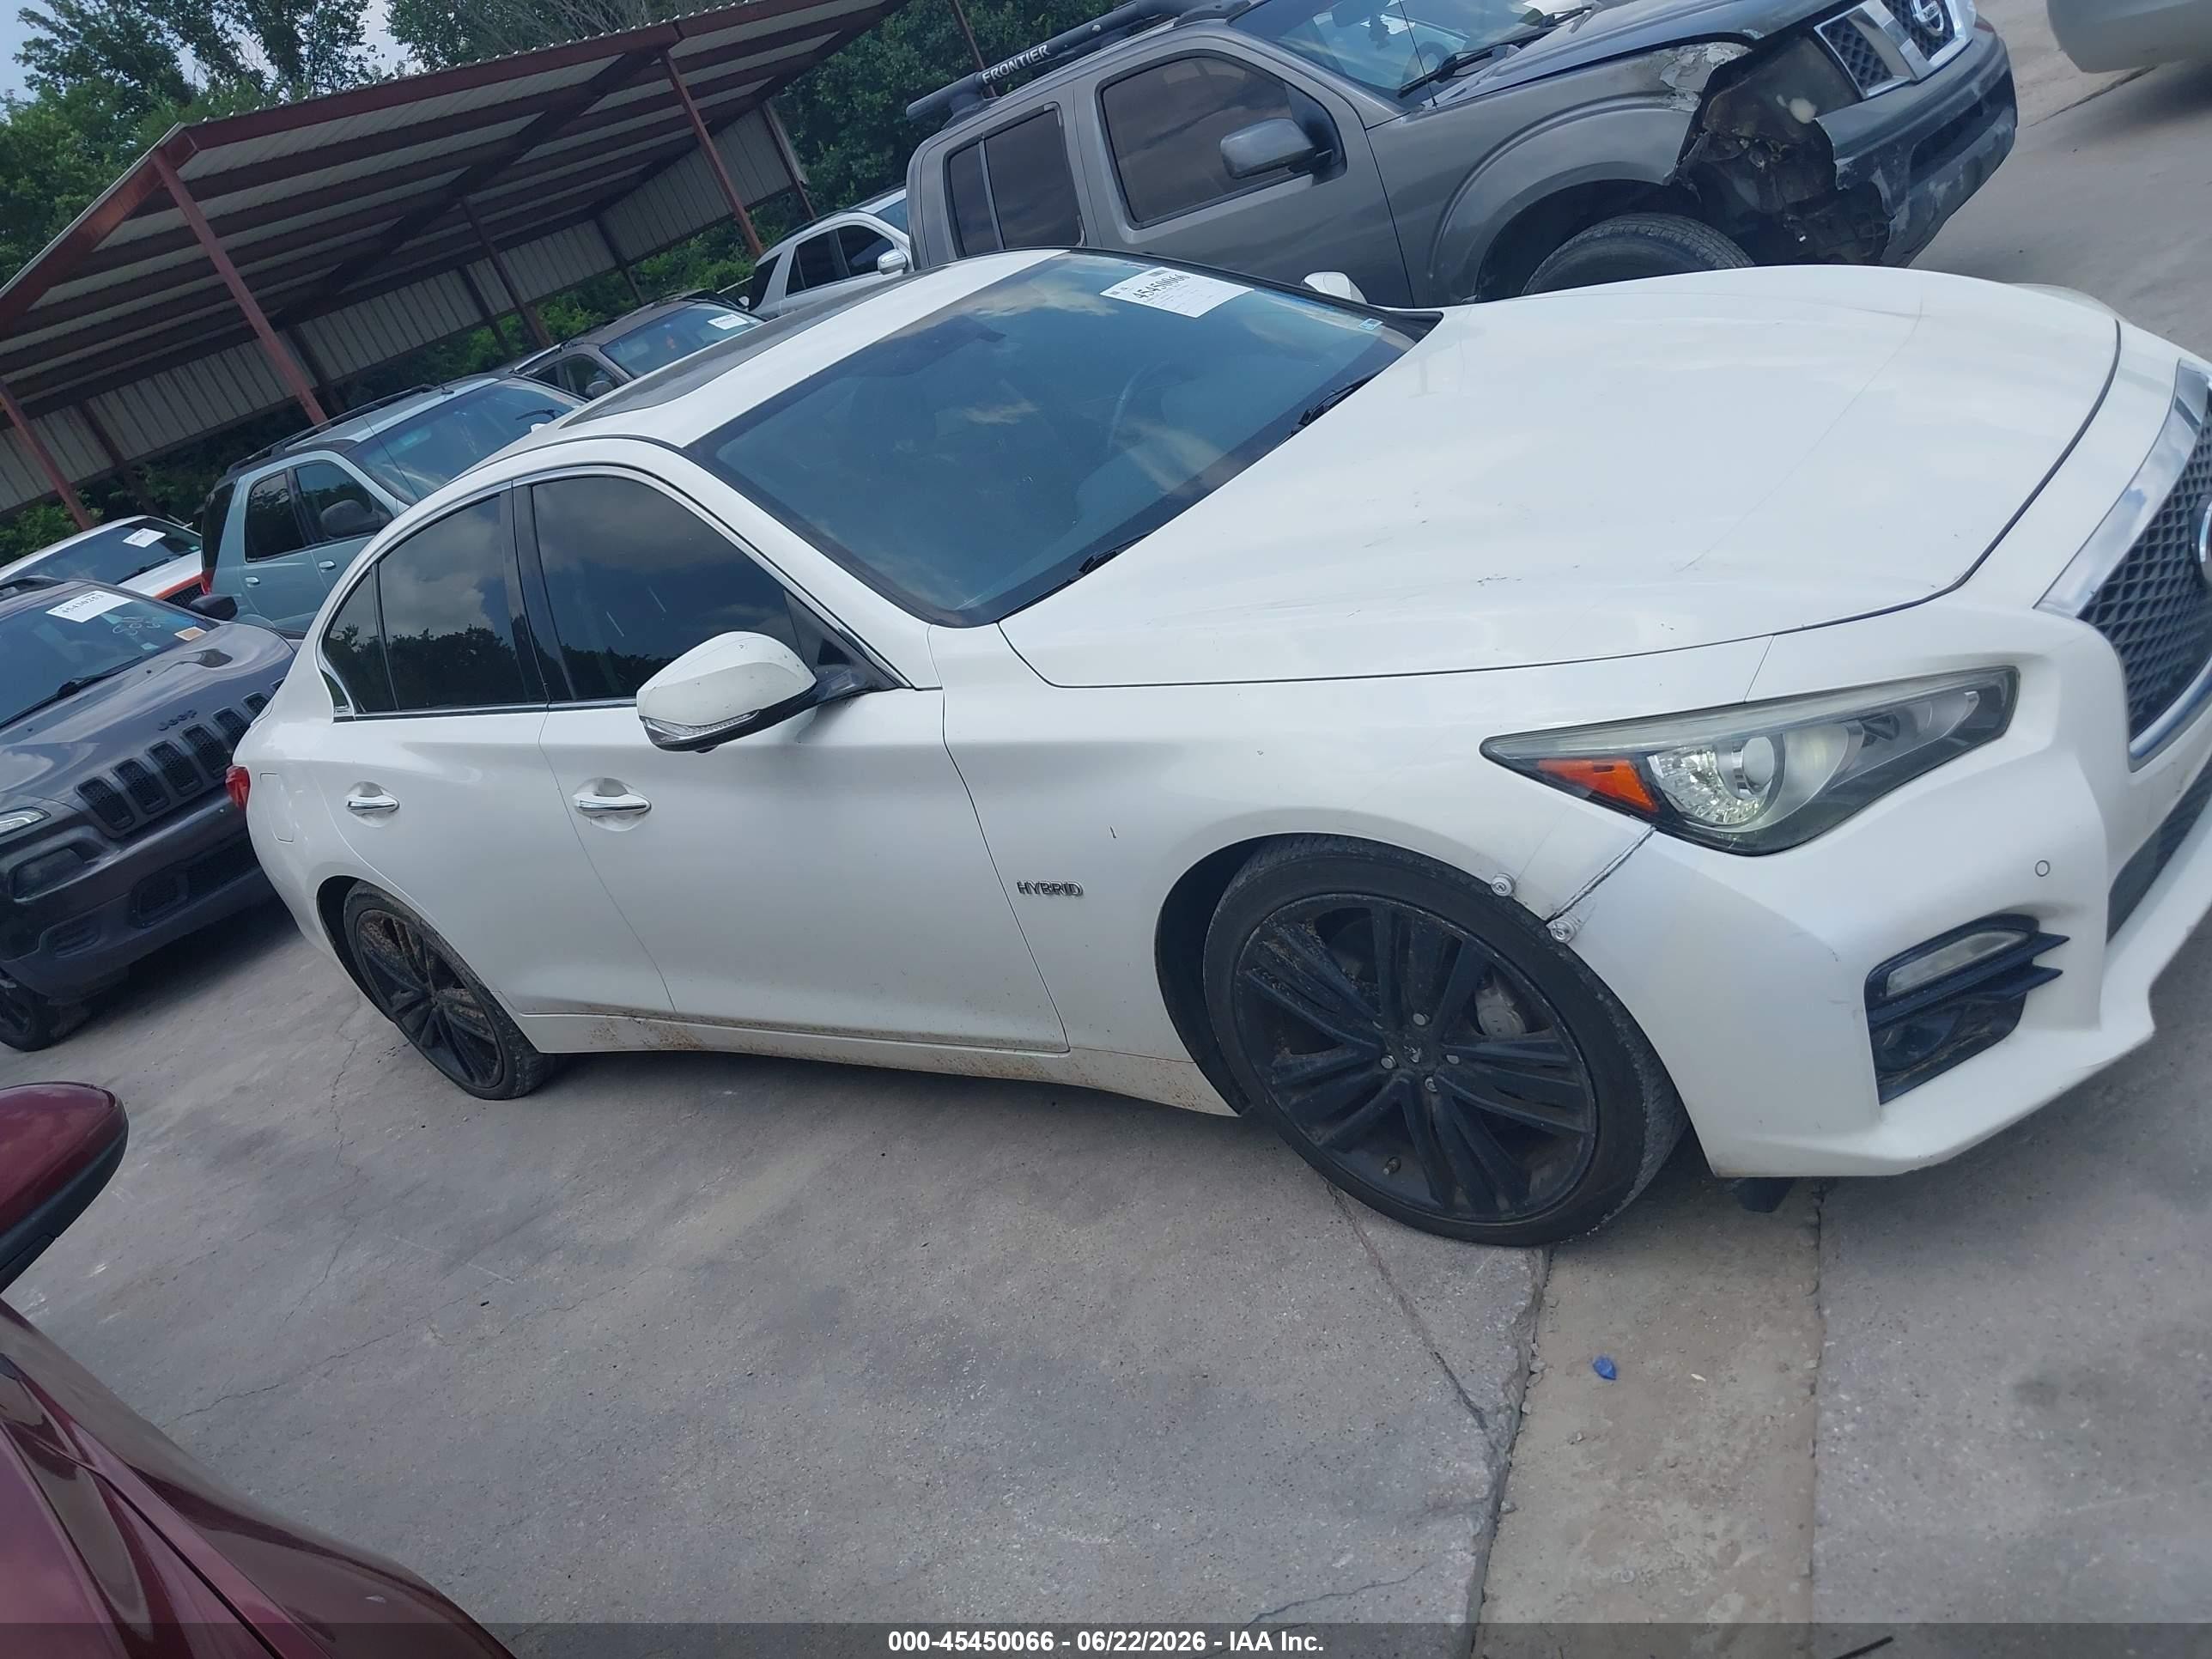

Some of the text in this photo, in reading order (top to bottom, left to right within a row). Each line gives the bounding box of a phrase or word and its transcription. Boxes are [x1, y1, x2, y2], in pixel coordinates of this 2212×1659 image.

[981, 44, 1051, 84] FRONTIER
[1133, 273, 1191, 299] 45450066
[157, 709, 198, 732] Jeep
[1016, 879, 1084, 896] HYBRID
